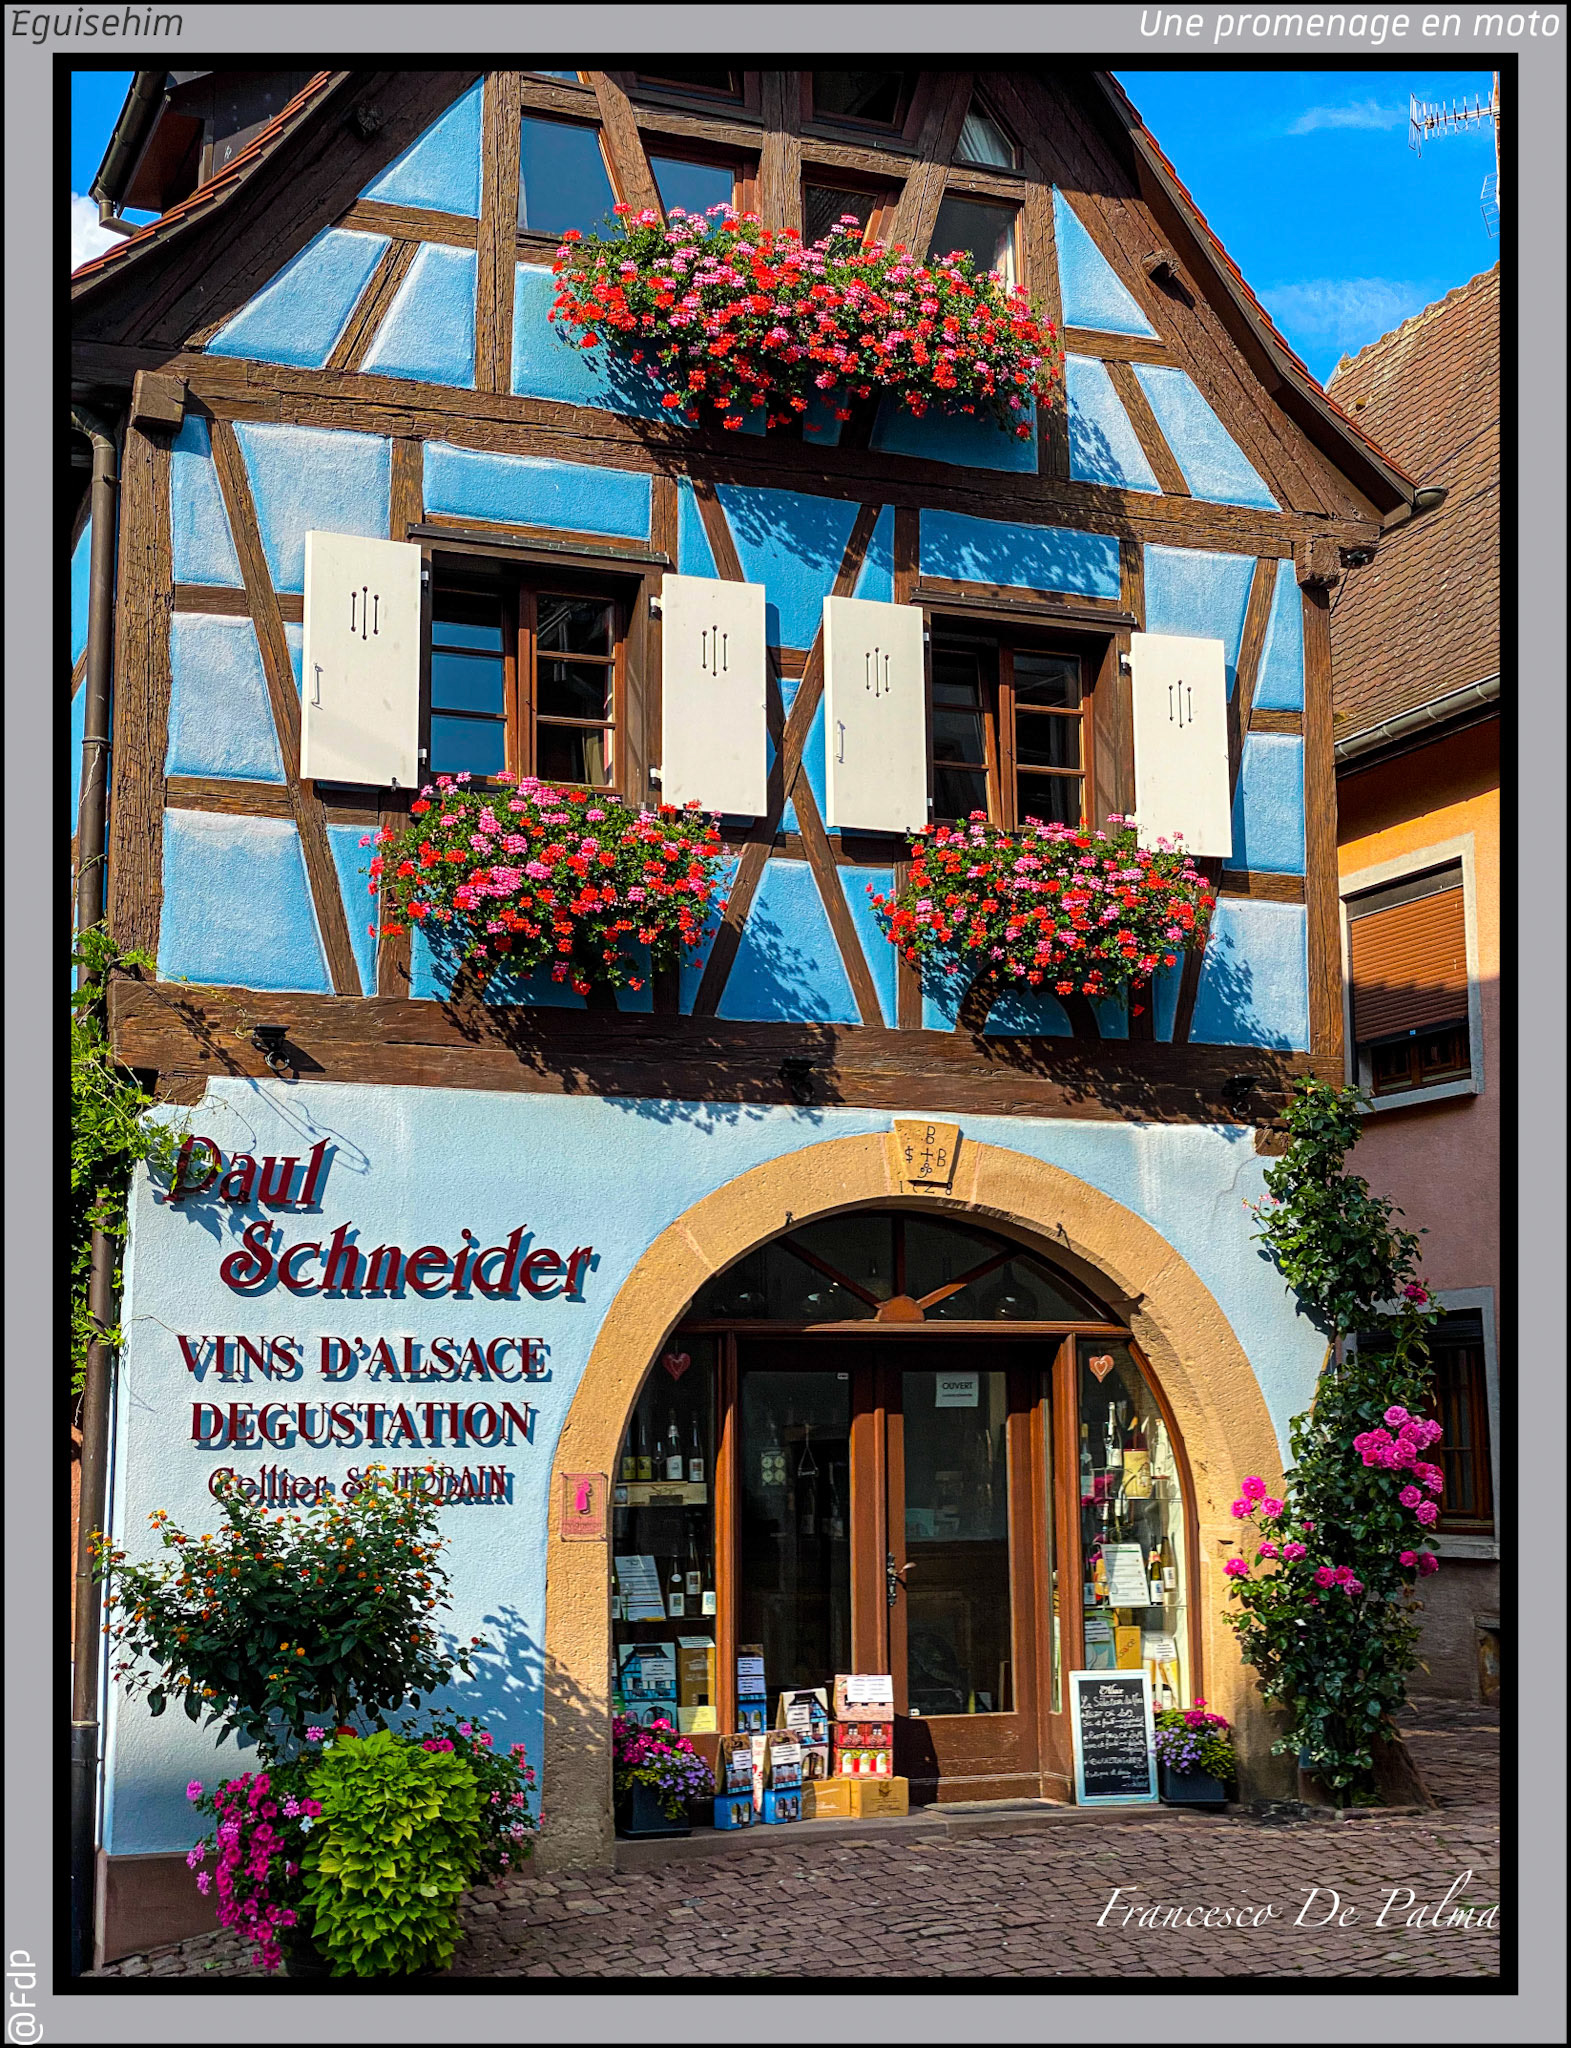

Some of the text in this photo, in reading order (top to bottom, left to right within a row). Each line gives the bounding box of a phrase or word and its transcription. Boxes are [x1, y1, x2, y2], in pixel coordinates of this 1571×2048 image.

[162, 1135, 331, 1206] Paul
[219, 1220, 593, 1295] Schneider
[176, 1335, 546, 1374] VINS D'ALSACE
[942, 1381, 973, 1390] OUVERT
[191, 1402, 530, 1441] DEGUSTATION
[208, 1464, 327, 1500] Cellier
